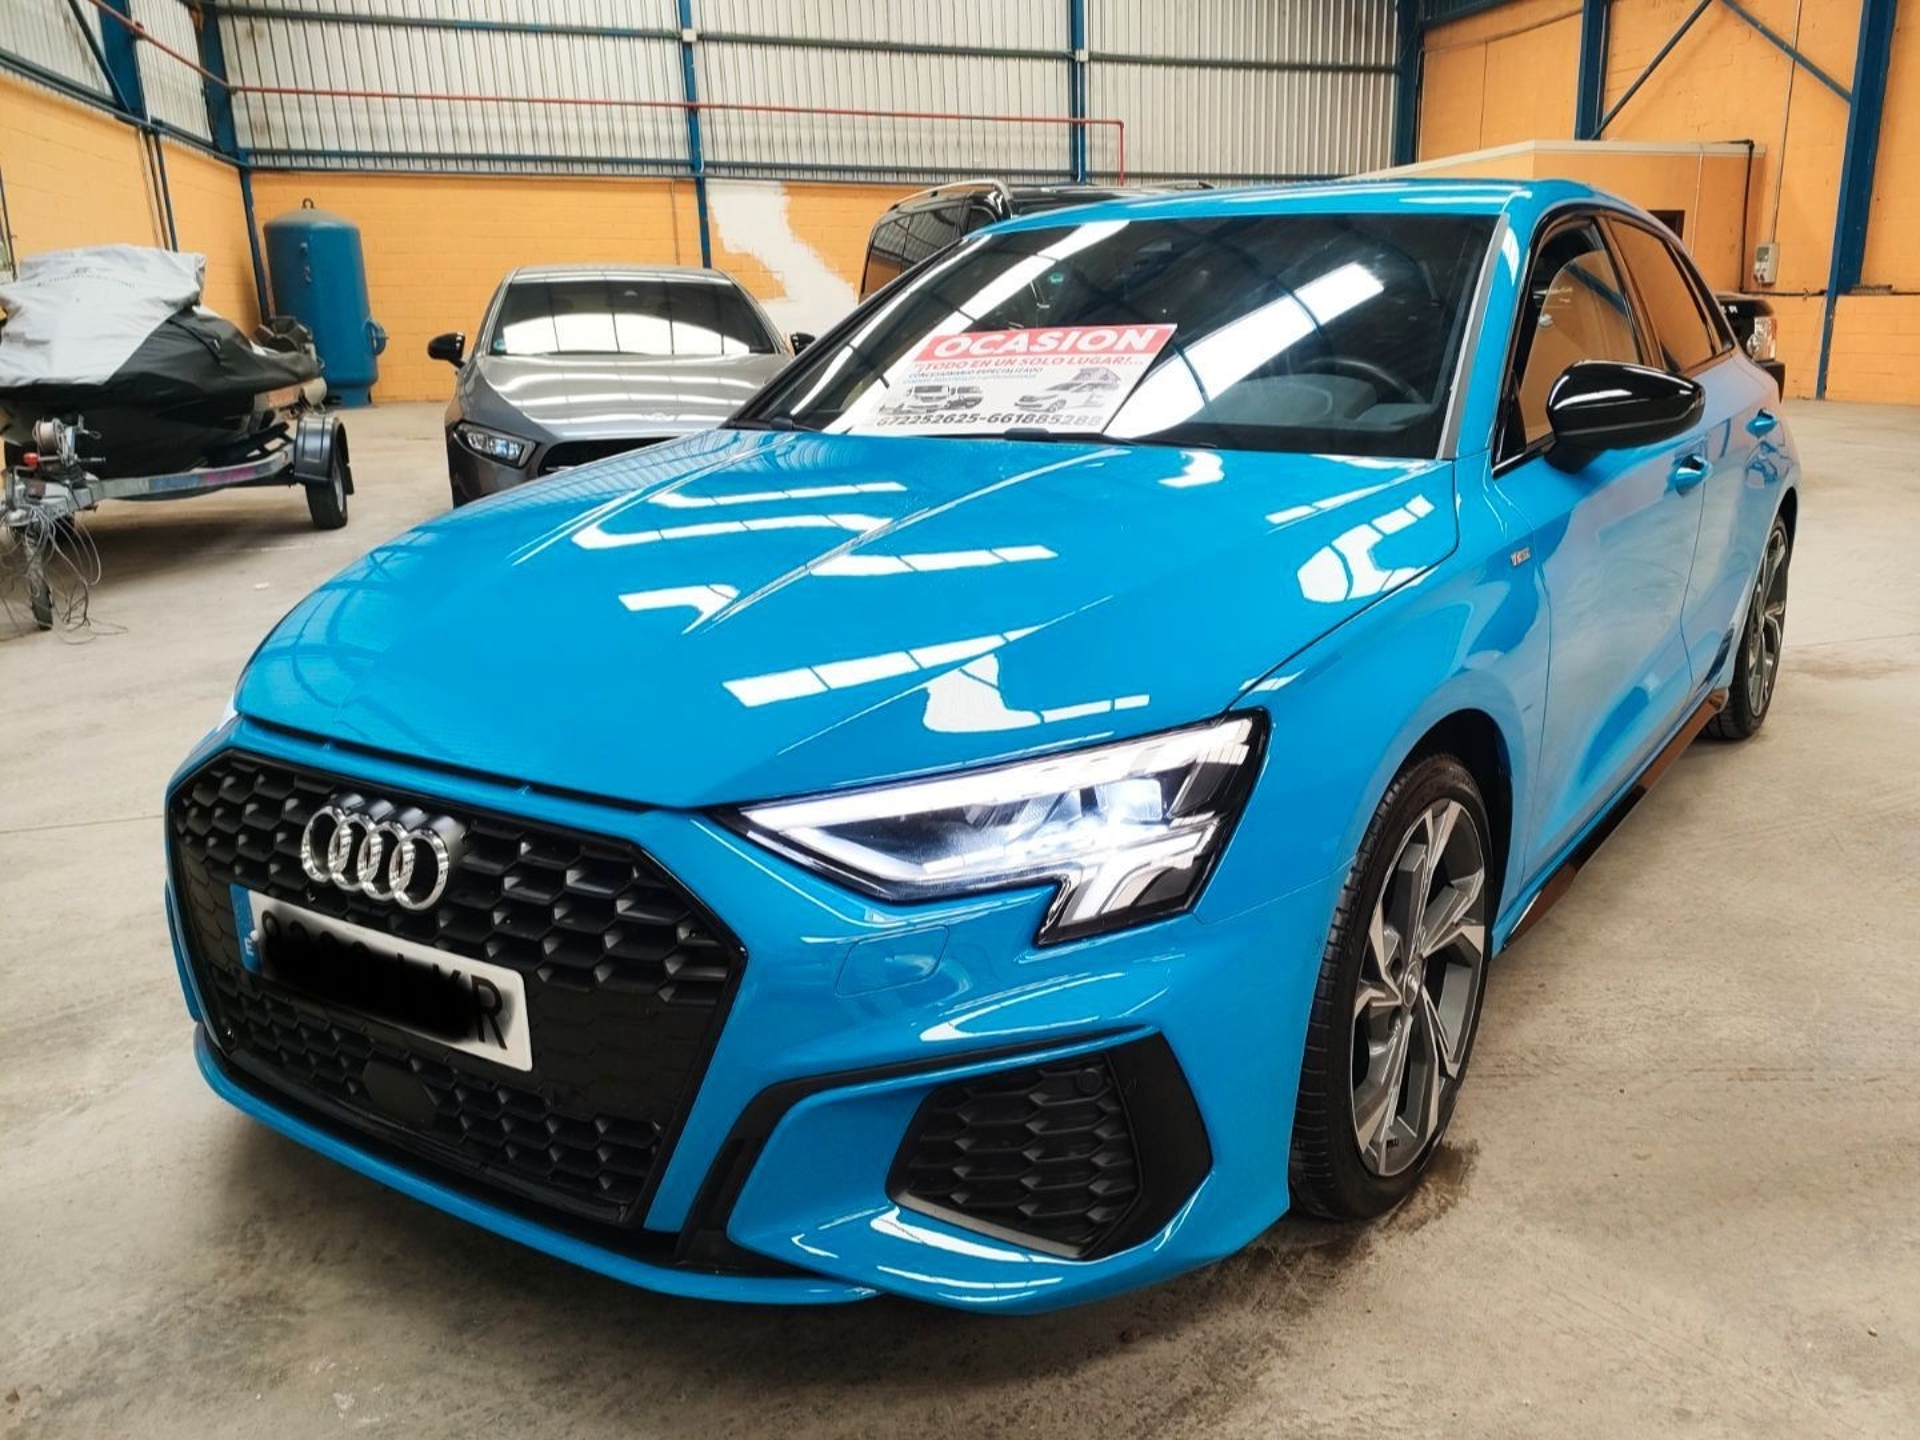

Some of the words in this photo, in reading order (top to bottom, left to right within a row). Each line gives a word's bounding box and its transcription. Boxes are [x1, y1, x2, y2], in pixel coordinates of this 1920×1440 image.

[932, 328, 1158, 358] OCASION
[970, 358, 994, 368] EN
[994, 357, 1016, 367] UN
[1018, 356, 1065, 366] SOLO
